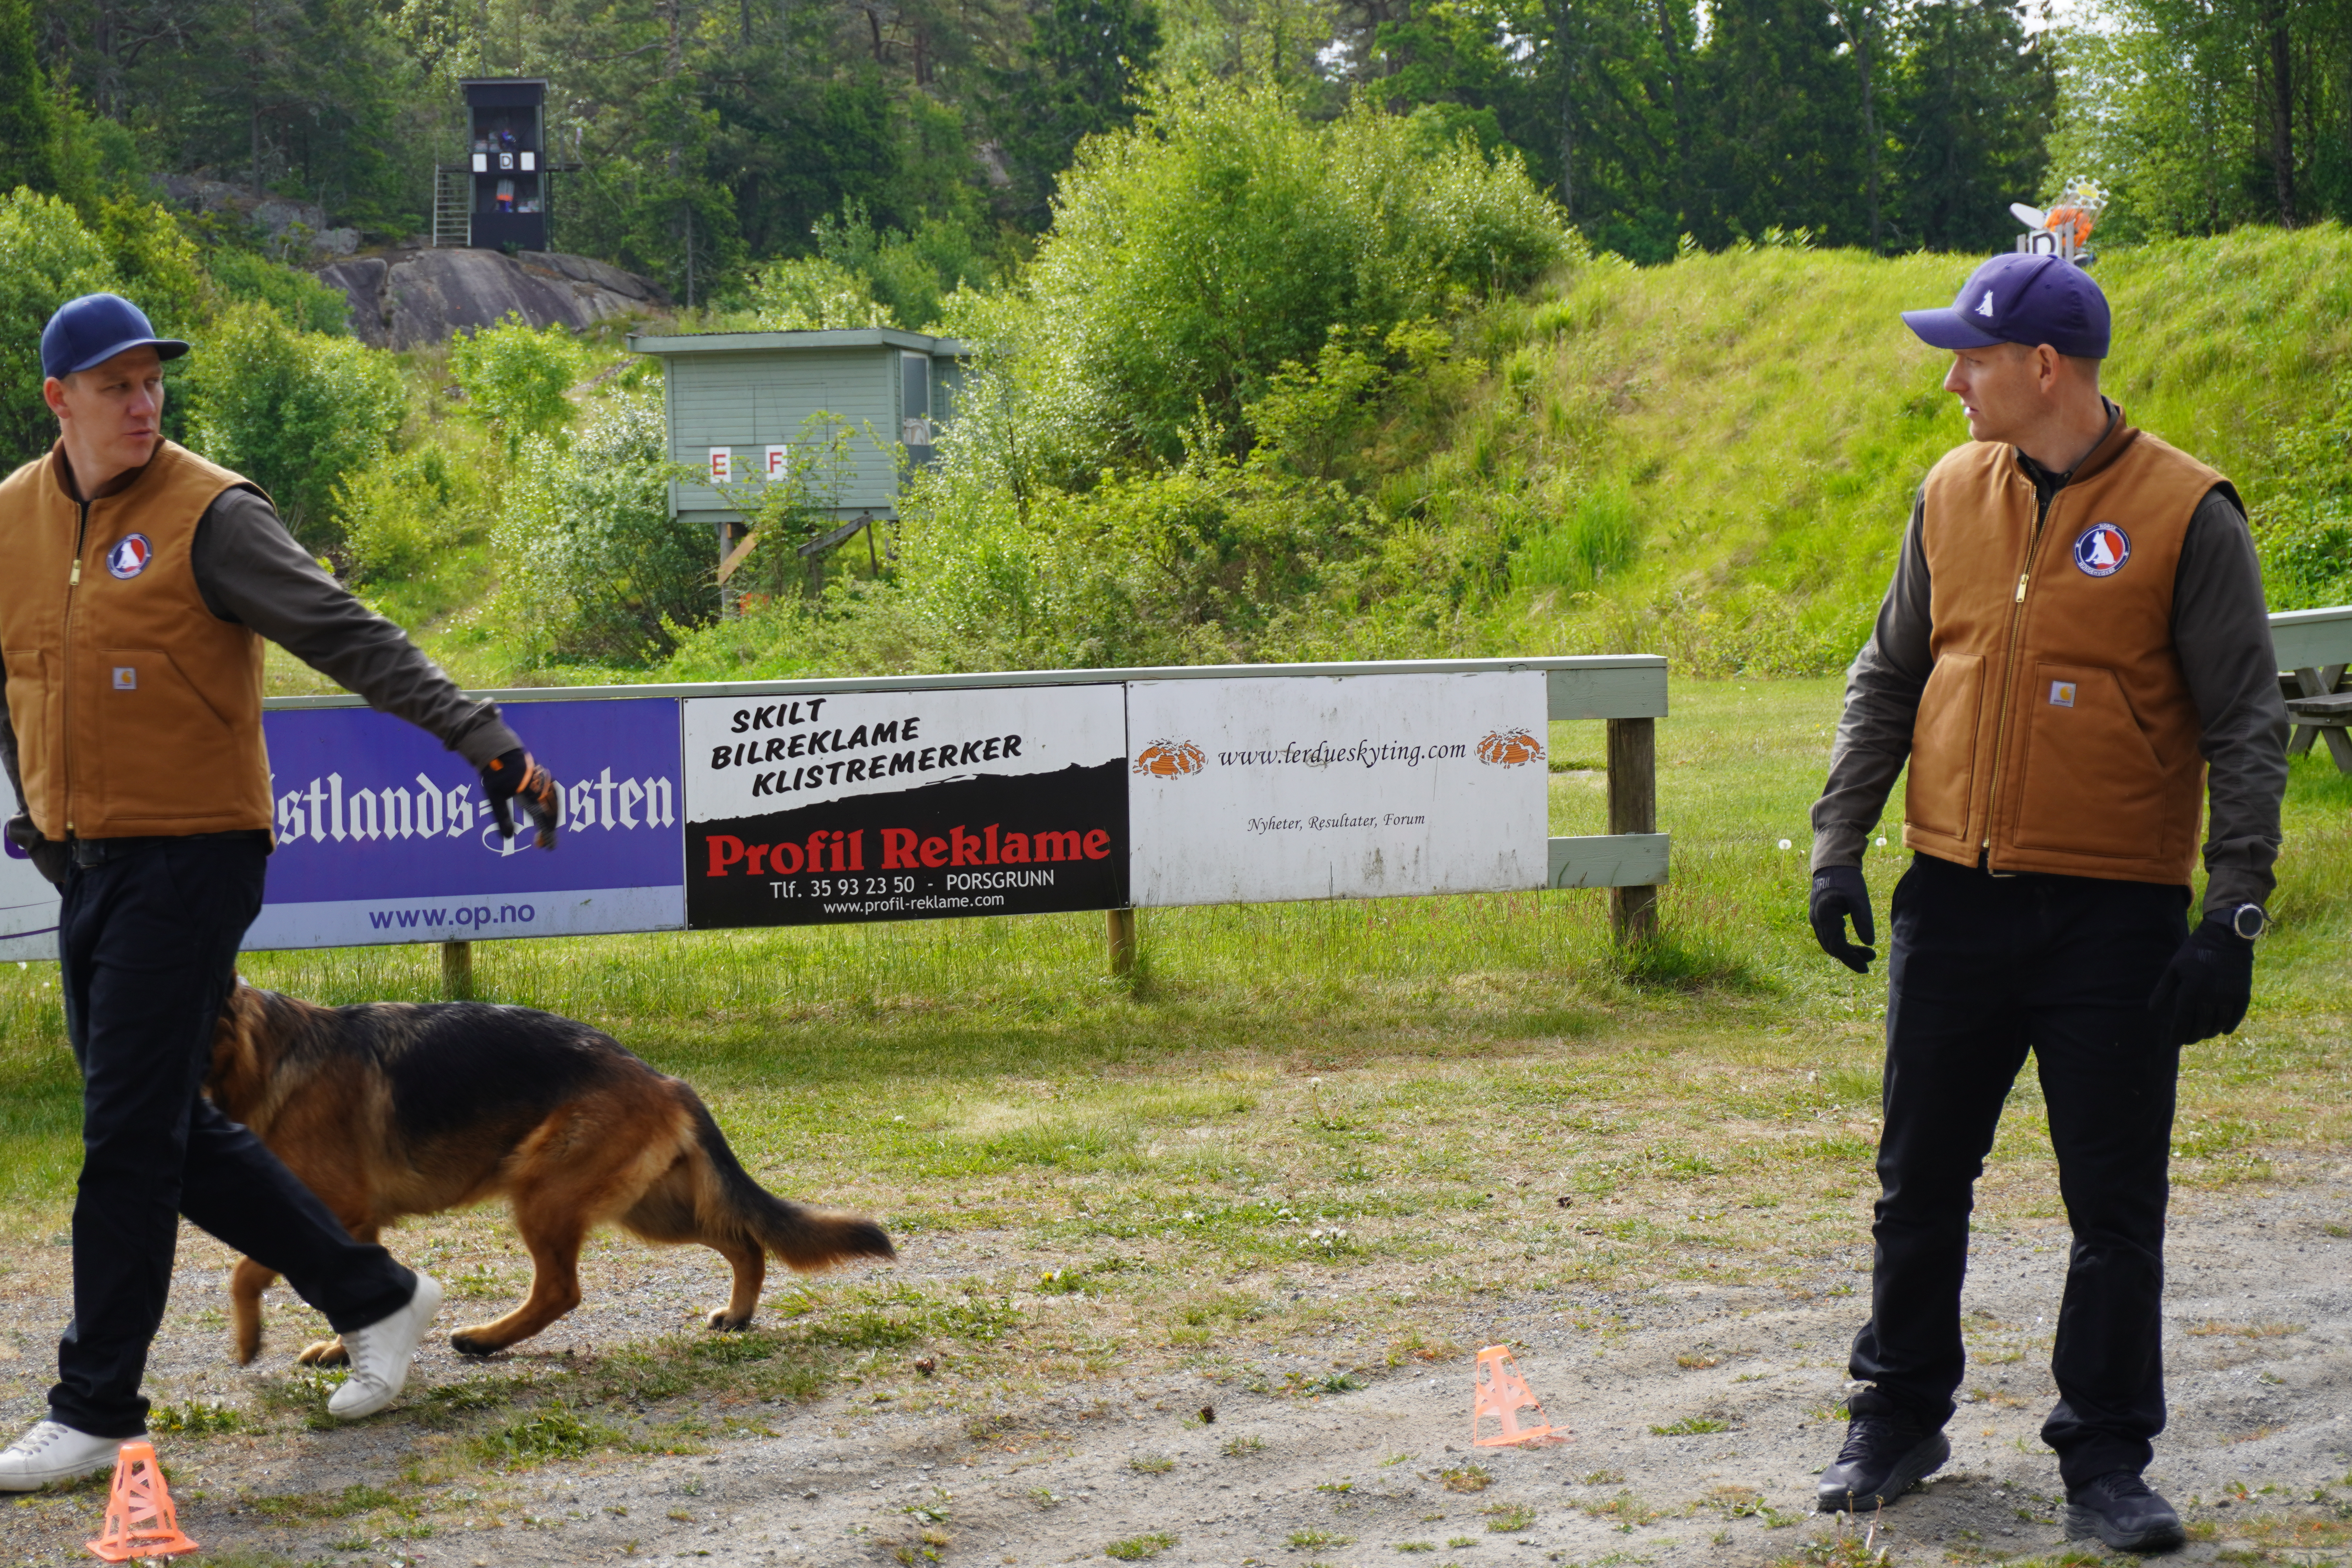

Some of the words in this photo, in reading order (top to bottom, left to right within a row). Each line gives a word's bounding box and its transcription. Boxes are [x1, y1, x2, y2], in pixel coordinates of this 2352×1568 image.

[502, 156, 511, 167] D
[713, 454, 727, 475] E
[769, 452, 783, 474] F
[731, 698, 826, 733] SKILT
[711, 717, 920, 769] BILREKLAME
[1218, 739, 1466, 768] www.lerdueskyting.com
[752, 735, 1022, 797] KLISTREMERKER
[1247, 816, 1303, 835] Nyheter,
[1308, 813, 1378, 831] Resultater,
[1383, 813, 1426, 826] Forum
[706, 829, 864, 877] Profil
[881, 824, 1110, 869] Reklame
[769, 881, 802, 899] Tlf.
[811, 880, 831, 897] 35
[838, 878, 859, 895] 93
[866, 877, 886, 894] 23
[894, 876, 915, 893] 50
[947, 869, 1054, 891] PORSGRUNN
[369, 904, 535, 931] www.op.no
[824, 895, 1004, 915] www.profil-reklame.com
